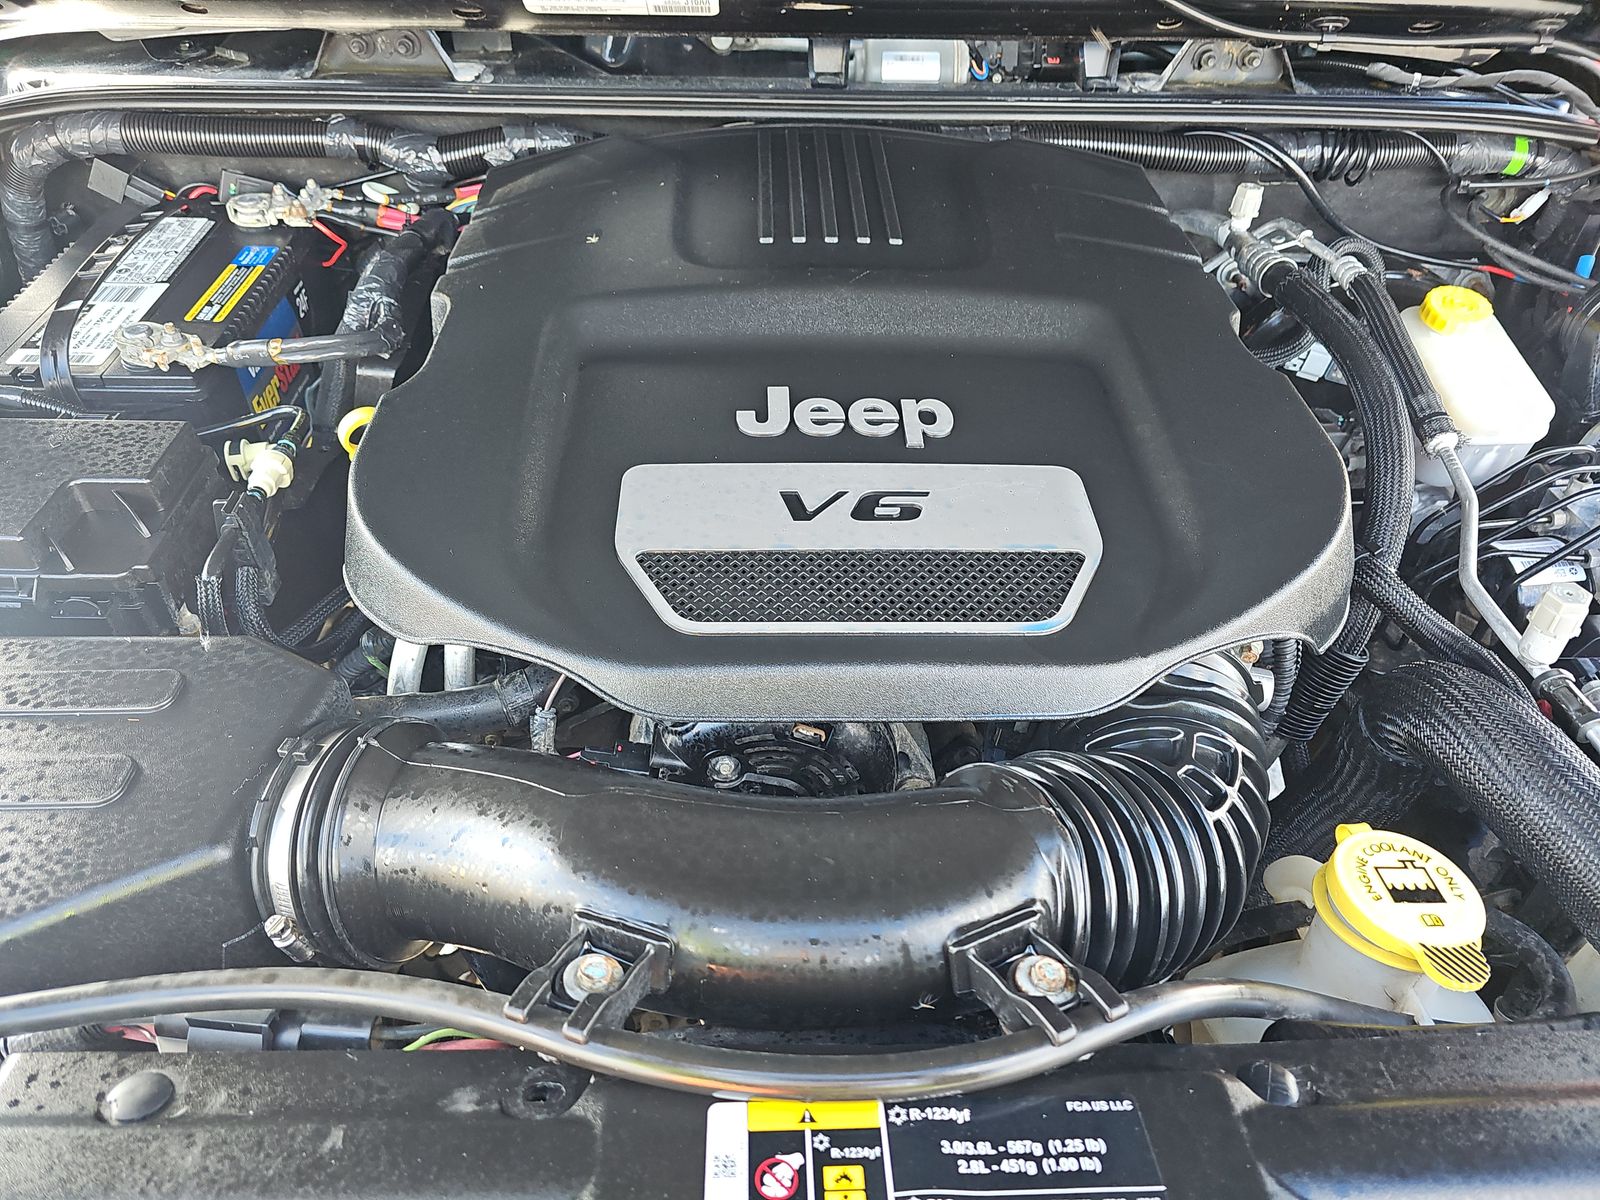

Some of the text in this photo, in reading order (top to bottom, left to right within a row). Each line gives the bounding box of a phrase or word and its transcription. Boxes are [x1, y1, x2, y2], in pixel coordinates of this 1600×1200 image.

[736, 386, 954, 448] Jeep
[779, 490, 930, 521] V6
[1356, 842, 1465, 901] ENGINE COOLANT ONLY
[908, 1106, 971, 1124] R-1234yf
[1066, 1100, 1134, 1112] FCA US LLC
[830, 1146, 881, 1160] R-1234yf
